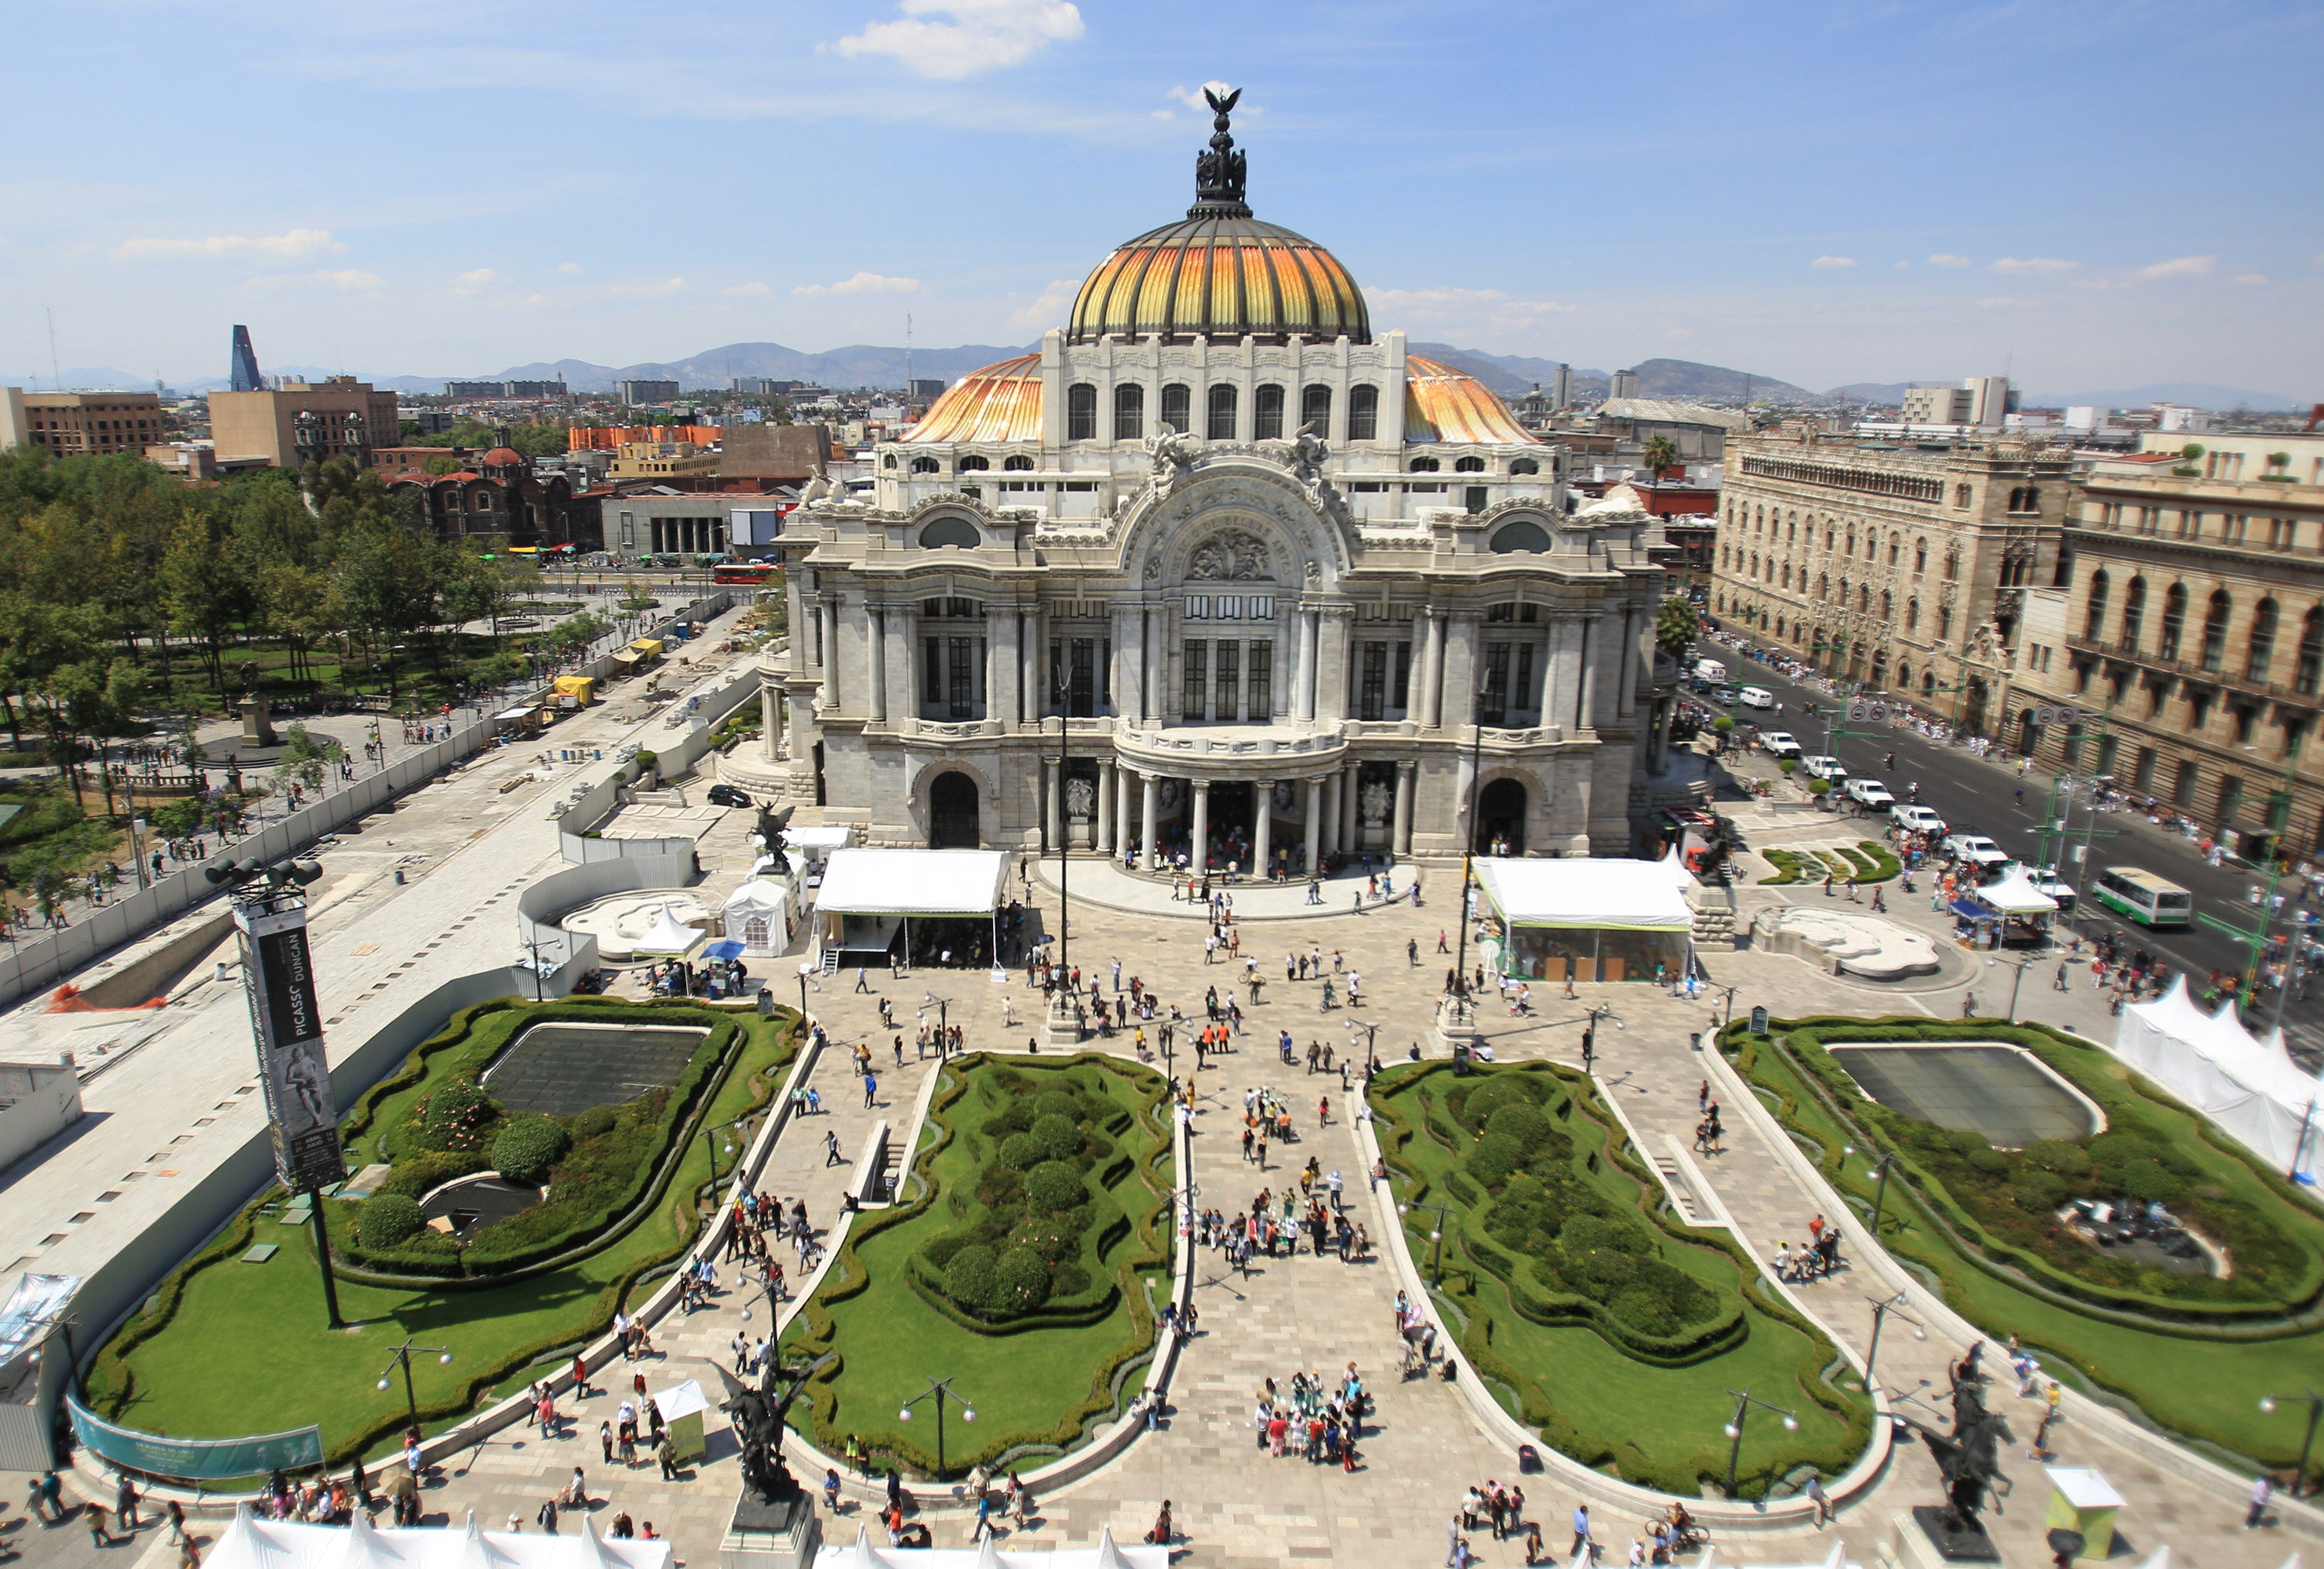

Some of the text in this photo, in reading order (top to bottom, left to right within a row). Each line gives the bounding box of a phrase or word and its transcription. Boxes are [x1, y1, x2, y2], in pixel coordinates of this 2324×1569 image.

[1171, 516, 1292, 576] PALACIO DE BELLAS ARTES
[288, 934, 304, 982] DUNCAN
[305, 1135, 322, 1144] ABRIL
[306, 1140, 323, 1149] JULIO
